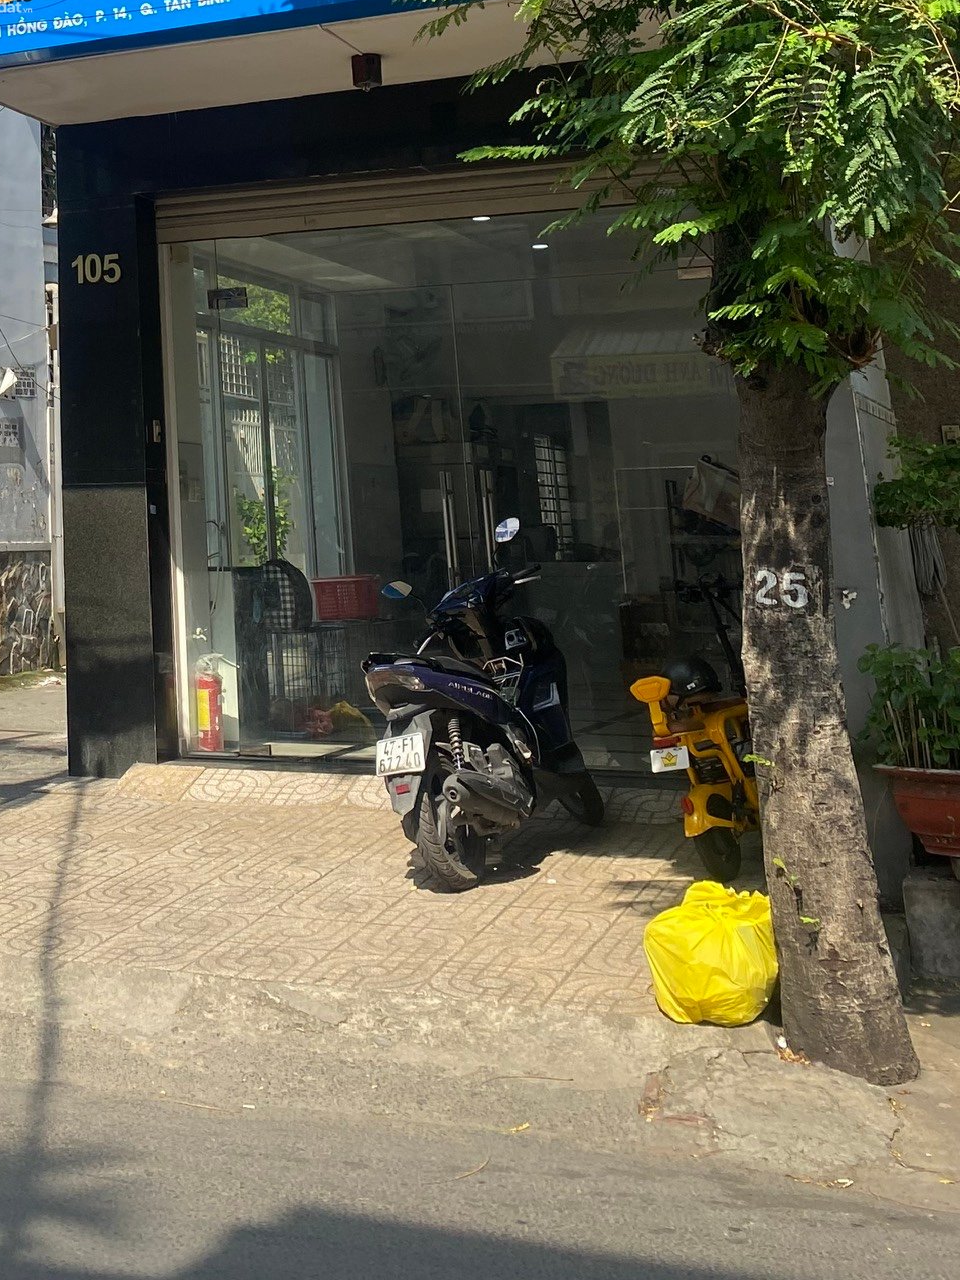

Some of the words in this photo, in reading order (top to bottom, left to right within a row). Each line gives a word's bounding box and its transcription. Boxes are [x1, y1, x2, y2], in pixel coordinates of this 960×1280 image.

[7, 15, 48, 36] HỒNG
[71, 253, 121, 284] 105
[754, 569, 810, 608] 25
